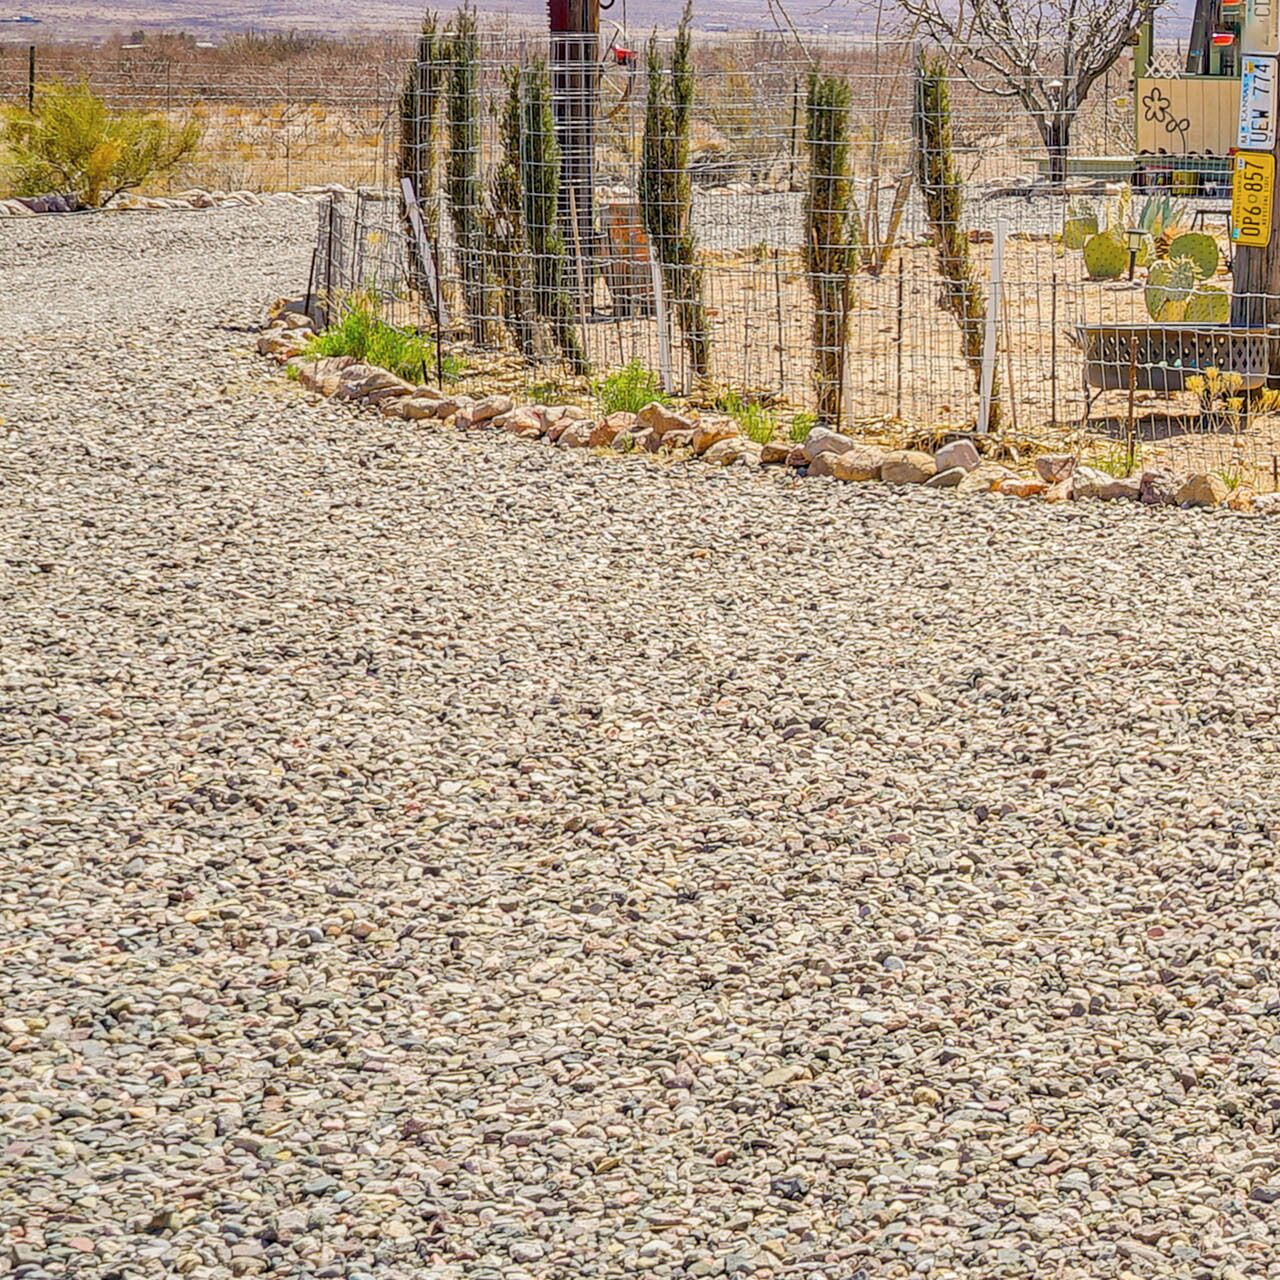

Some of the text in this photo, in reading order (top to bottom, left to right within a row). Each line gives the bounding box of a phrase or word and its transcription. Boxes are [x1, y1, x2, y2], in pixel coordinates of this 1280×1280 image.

[1251, 64, 1270, 142] UEW 774
[1244, 161, 1264, 192] 857
